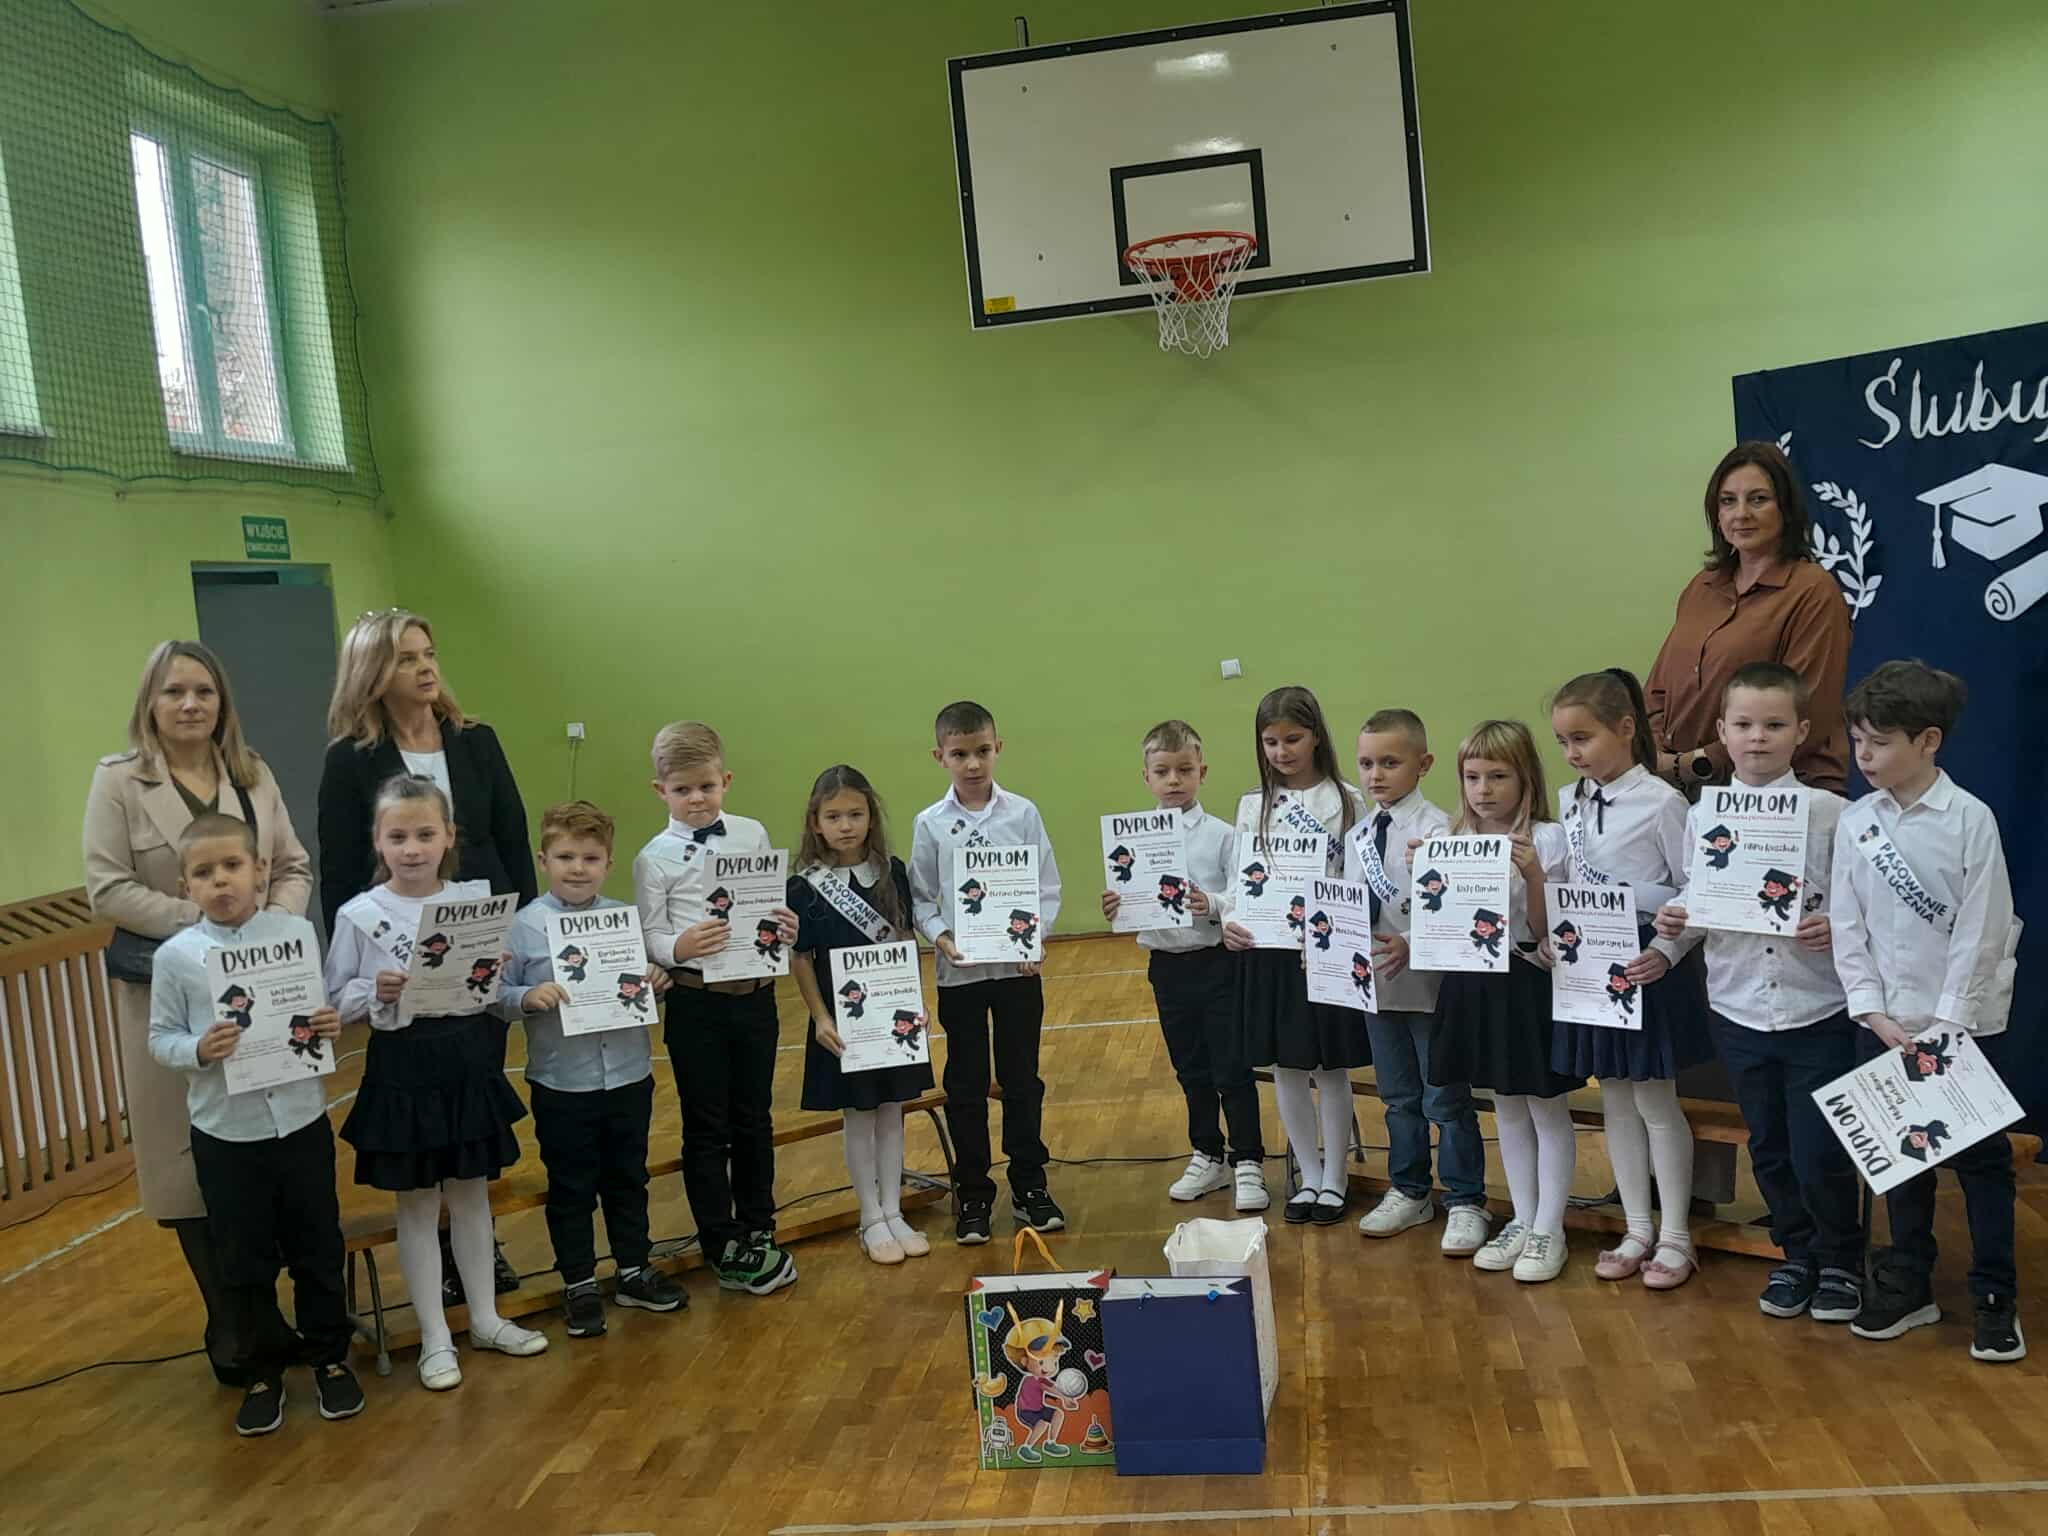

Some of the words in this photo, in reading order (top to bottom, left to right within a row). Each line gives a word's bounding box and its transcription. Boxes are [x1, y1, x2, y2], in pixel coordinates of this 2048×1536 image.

[1858, 357, 2048, 448] Ślubu
[1716, 791, 1798, 815] DYPLOM
[1112, 814, 1174, 837] DYPLOM
[965, 849, 1029, 870] DYPLOM
[1428, 839, 1501, 859] DYPLOM
[715, 854, 779, 877] DYPLOM
[1313, 879, 1363, 905] DYPLOM
[1871, 854, 1889, 877] NA
[1888, 875, 1935, 925] UCZNIA
[1880, 842, 1949, 917] PASOWANIE
[818, 881, 834, 898] NA
[833, 895, 869, 930] UCZNIA
[824, 872, 880, 924] PASOWANIE
[1557, 887, 1626, 912] DYPLOM
[434, 899, 508, 924] DYPLOM
[559, 911, 630, 935] DYPLOM
[220, 938, 304, 973] DYPLOM
[843, 946, 908, 970] DYPLOM
[1826, 1093, 1893, 1177] DYPLOM
